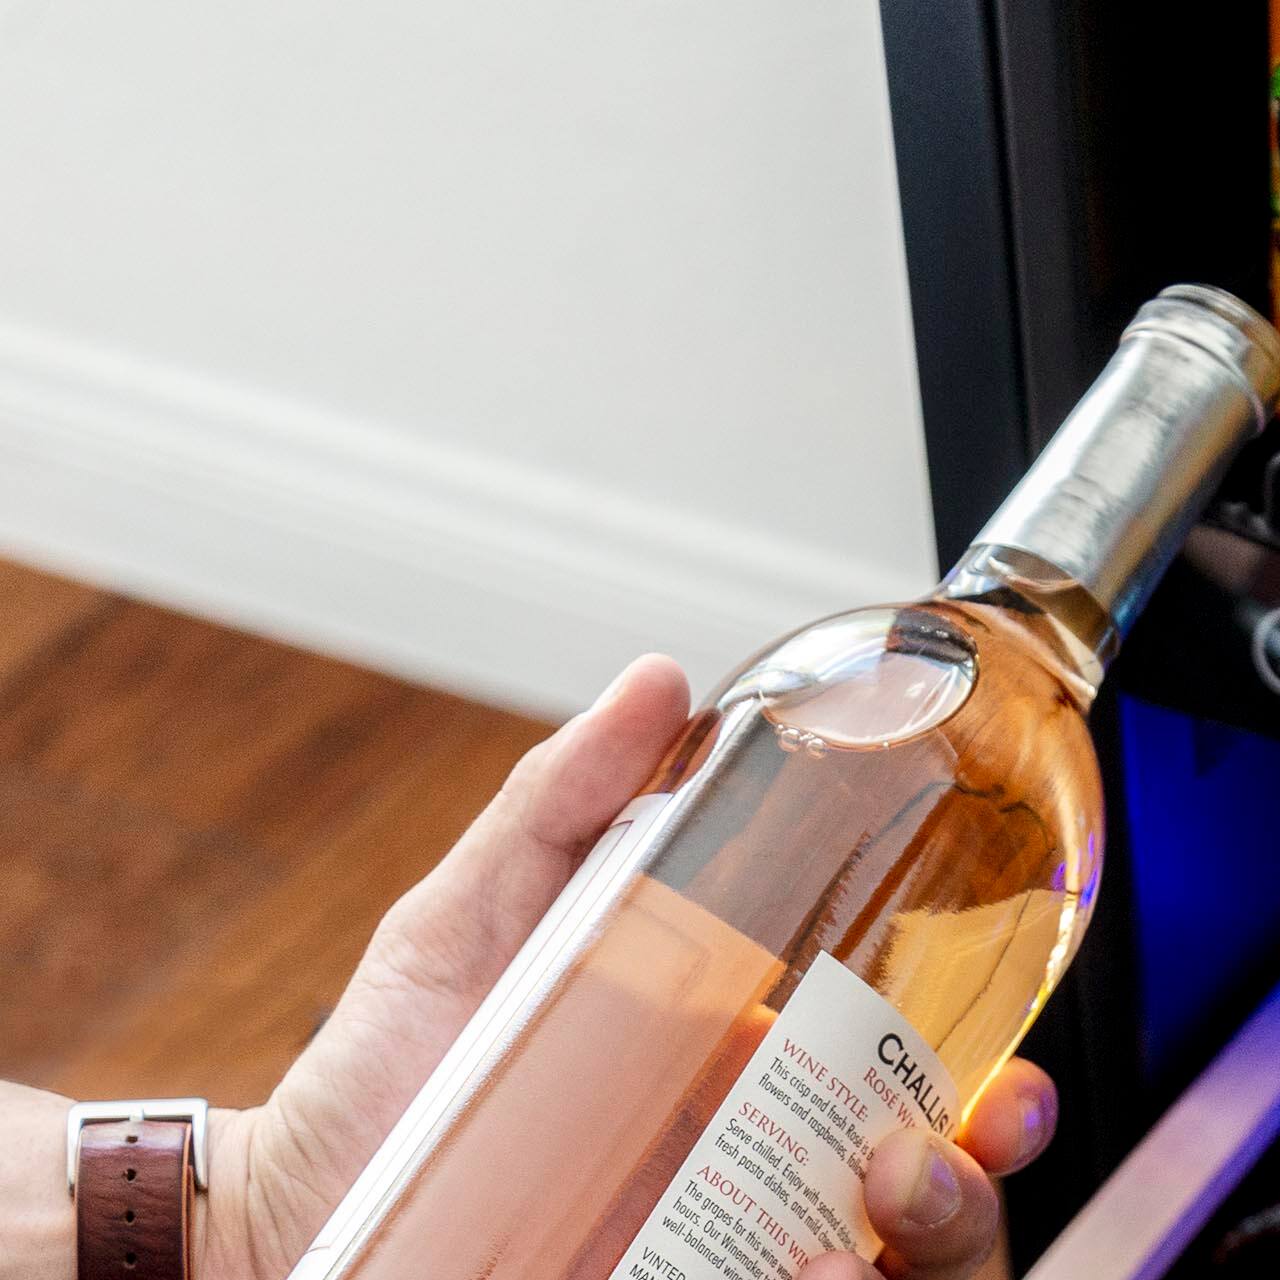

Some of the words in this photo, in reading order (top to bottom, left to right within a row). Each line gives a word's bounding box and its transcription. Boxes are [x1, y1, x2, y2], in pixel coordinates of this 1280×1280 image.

[758, 1072, 791, 1107] flowers
[790, 1101, 812, 1121] and
[769, 1056, 790, 1080] This
[789, 1075, 811, 1098] crisp
[810, 1093, 833, 1115] and
[827, 1103, 848, 1132] fresh
[783, 1038, 829, 1083] WINE
[826, 1076, 869, 1123] STYLE:
[863, 1066, 901, 1109] ROSÉ
[725, 1118, 752, 1145] Serve
[751, 1139, 783, 1172] chilled.
[782, 1163, 805, 1193] Enjoy
[802, 1185, 820, 1207] with
[738, 1101, 811, 1167] SERVING:
[696, 1165, 757, 1214] ABOUT
[755, 1207, 790, 1247] THIS
[788, 1239, 809, 1270] WIN
[714, 1134, 739, 1160] fresh
[736, 1153, 765, 1180] pasta
[763, 1174, 791, 1206] dishes,
[790, 1201, 809, 1220] and
[661, 1215, 725, 1270] well-balanced
[672, 1195, 701, 1227] hours.
[703, 1219, 722, 1241] Our
[720, 1232, 764, 1280] Winemaker
[683, 1180, 702, 1202] The
[700, 1196, 734, 1227] grapes
[734, 1217, 748, 1237] for
[745, 1230, 762, 1252] this
[759, 1245, 779, 1268] wine
